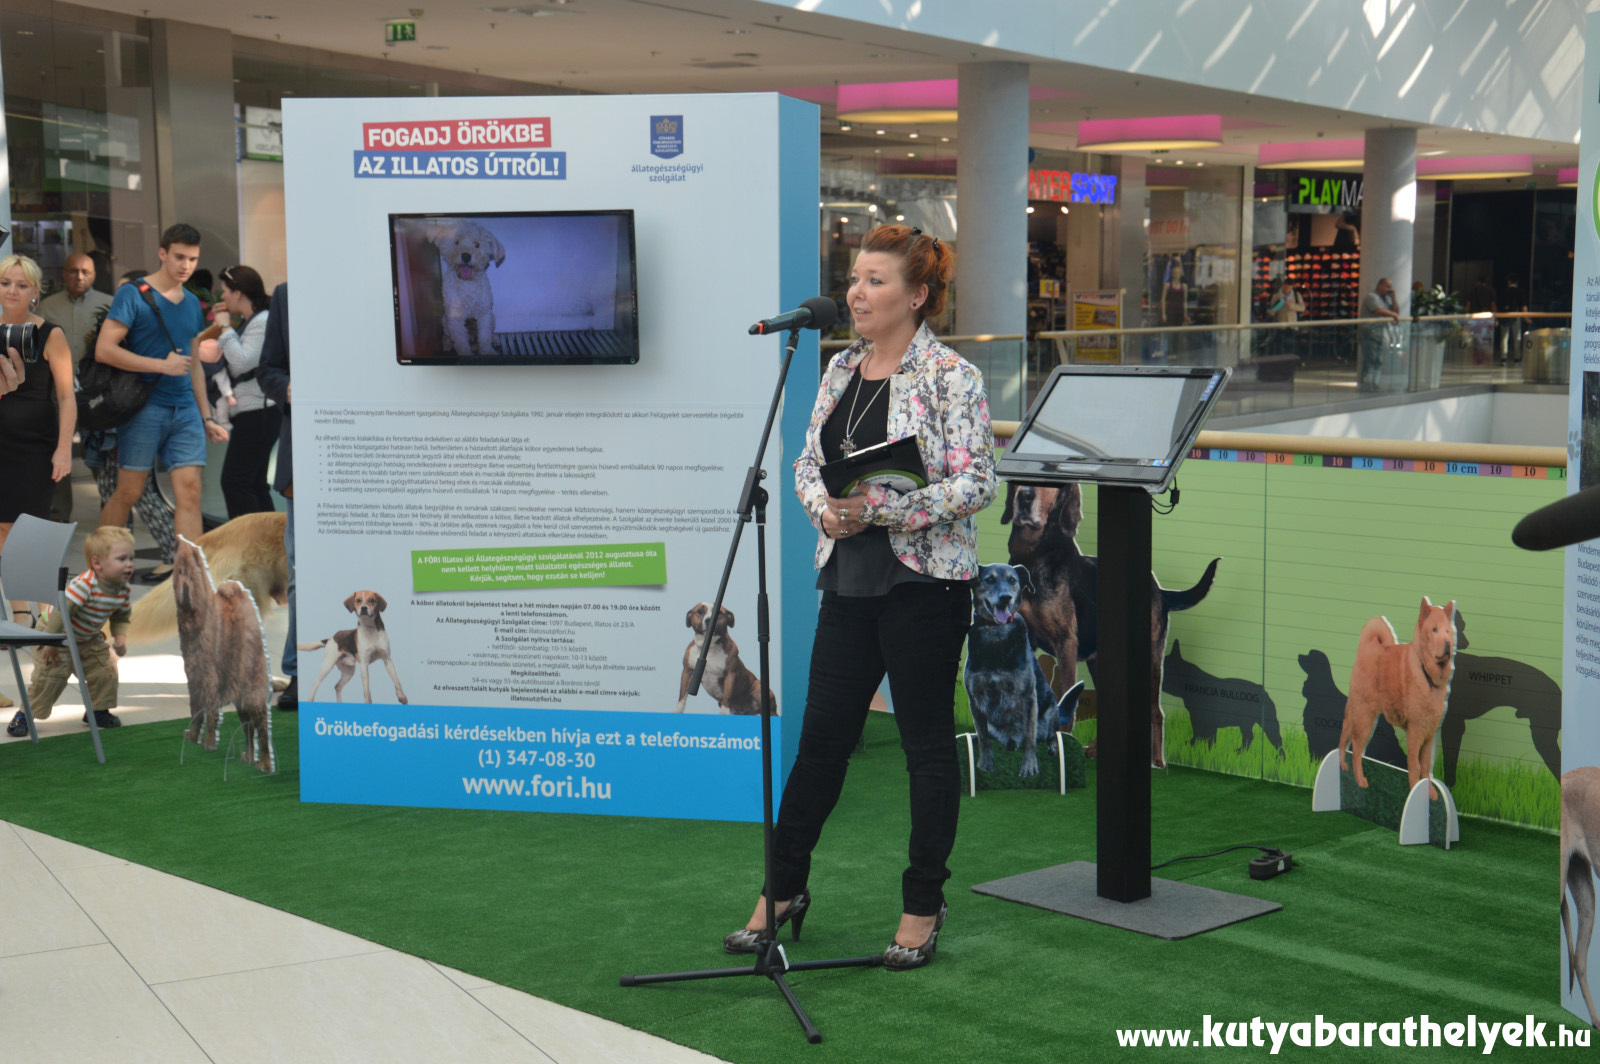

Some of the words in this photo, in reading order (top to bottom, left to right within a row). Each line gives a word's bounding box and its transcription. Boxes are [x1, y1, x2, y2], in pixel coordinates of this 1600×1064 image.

[368, 126, 450, 147] FOGADJ
[457, 120, 545, 145] ÖRÖKBE
[358, 156, 386, 175] AZ
[391, 156, 479, 175] ILLATOS
[484, 151, 559, 176] ÚTRÓL!
[631, 163, 703, 174] állategészségügyi
[649, 174, 686, 183] szolgálat
[1029, 169, 1117, 204] NTERSPORT
[1299, 177, 1364, 206] PLAYMA
[1585, 322, 1600, 333] kedve
[1584, 340, 1600, 351] progra
[1218, 450, 1228, 459] 10
[1246, 452, 1256, 461] 10
[1275, 453, 1284, 463] 10
[1303, 455, 1313, 464] 10
[1332, 457, 1343, 466] 10
[1363, 458, 1373, 467] 10
[1393, 460, 1403, 470] 10
[1424, 461, 1434, 471] 10
[1446, 463, 1457, 472] 10
[1490, 465, 1501, 475] 10
[1524, 466, 1535, 477] 10
[538, 552, 584, 561] szolgálatánál
[481, 563, 515, 573] helyhiány
[535, 562, 567, 570] túlaltatni
[568, 560, 608, 571] egészséges
[470, 573, 494, 583] Kérjük,
[495, 572, 526, 582] segítsen,
[526, 572, 545, 581] hogy
[580, 570, 604, 580] kelljen!
[466, 601, 500, 609] bejelentést
[1469, 671, 1512, 685] WHIPPET
[510, 686, 549, 695] bejelentését
[619, 689, 640, 697] várjuk:
[1185, 684, 1218, 697] FRANCIA
[1221, 688, 1259, 703] BULLDOG
[314, 718, 440, 742] Örökbefogadási
[444, 723, 547, 744] kérdésekben
[551, 727, 591, 747] hívja
[595, 732, 622, 746] ezt
[625, 735, 635, 747] a
[639, 731, 761, 751] telefonszámot
[478, 748, 501, 768] (1)
[507, 750, 596, 768] 347-08-30
[462, 773, 612, 800] www.fori.hu
